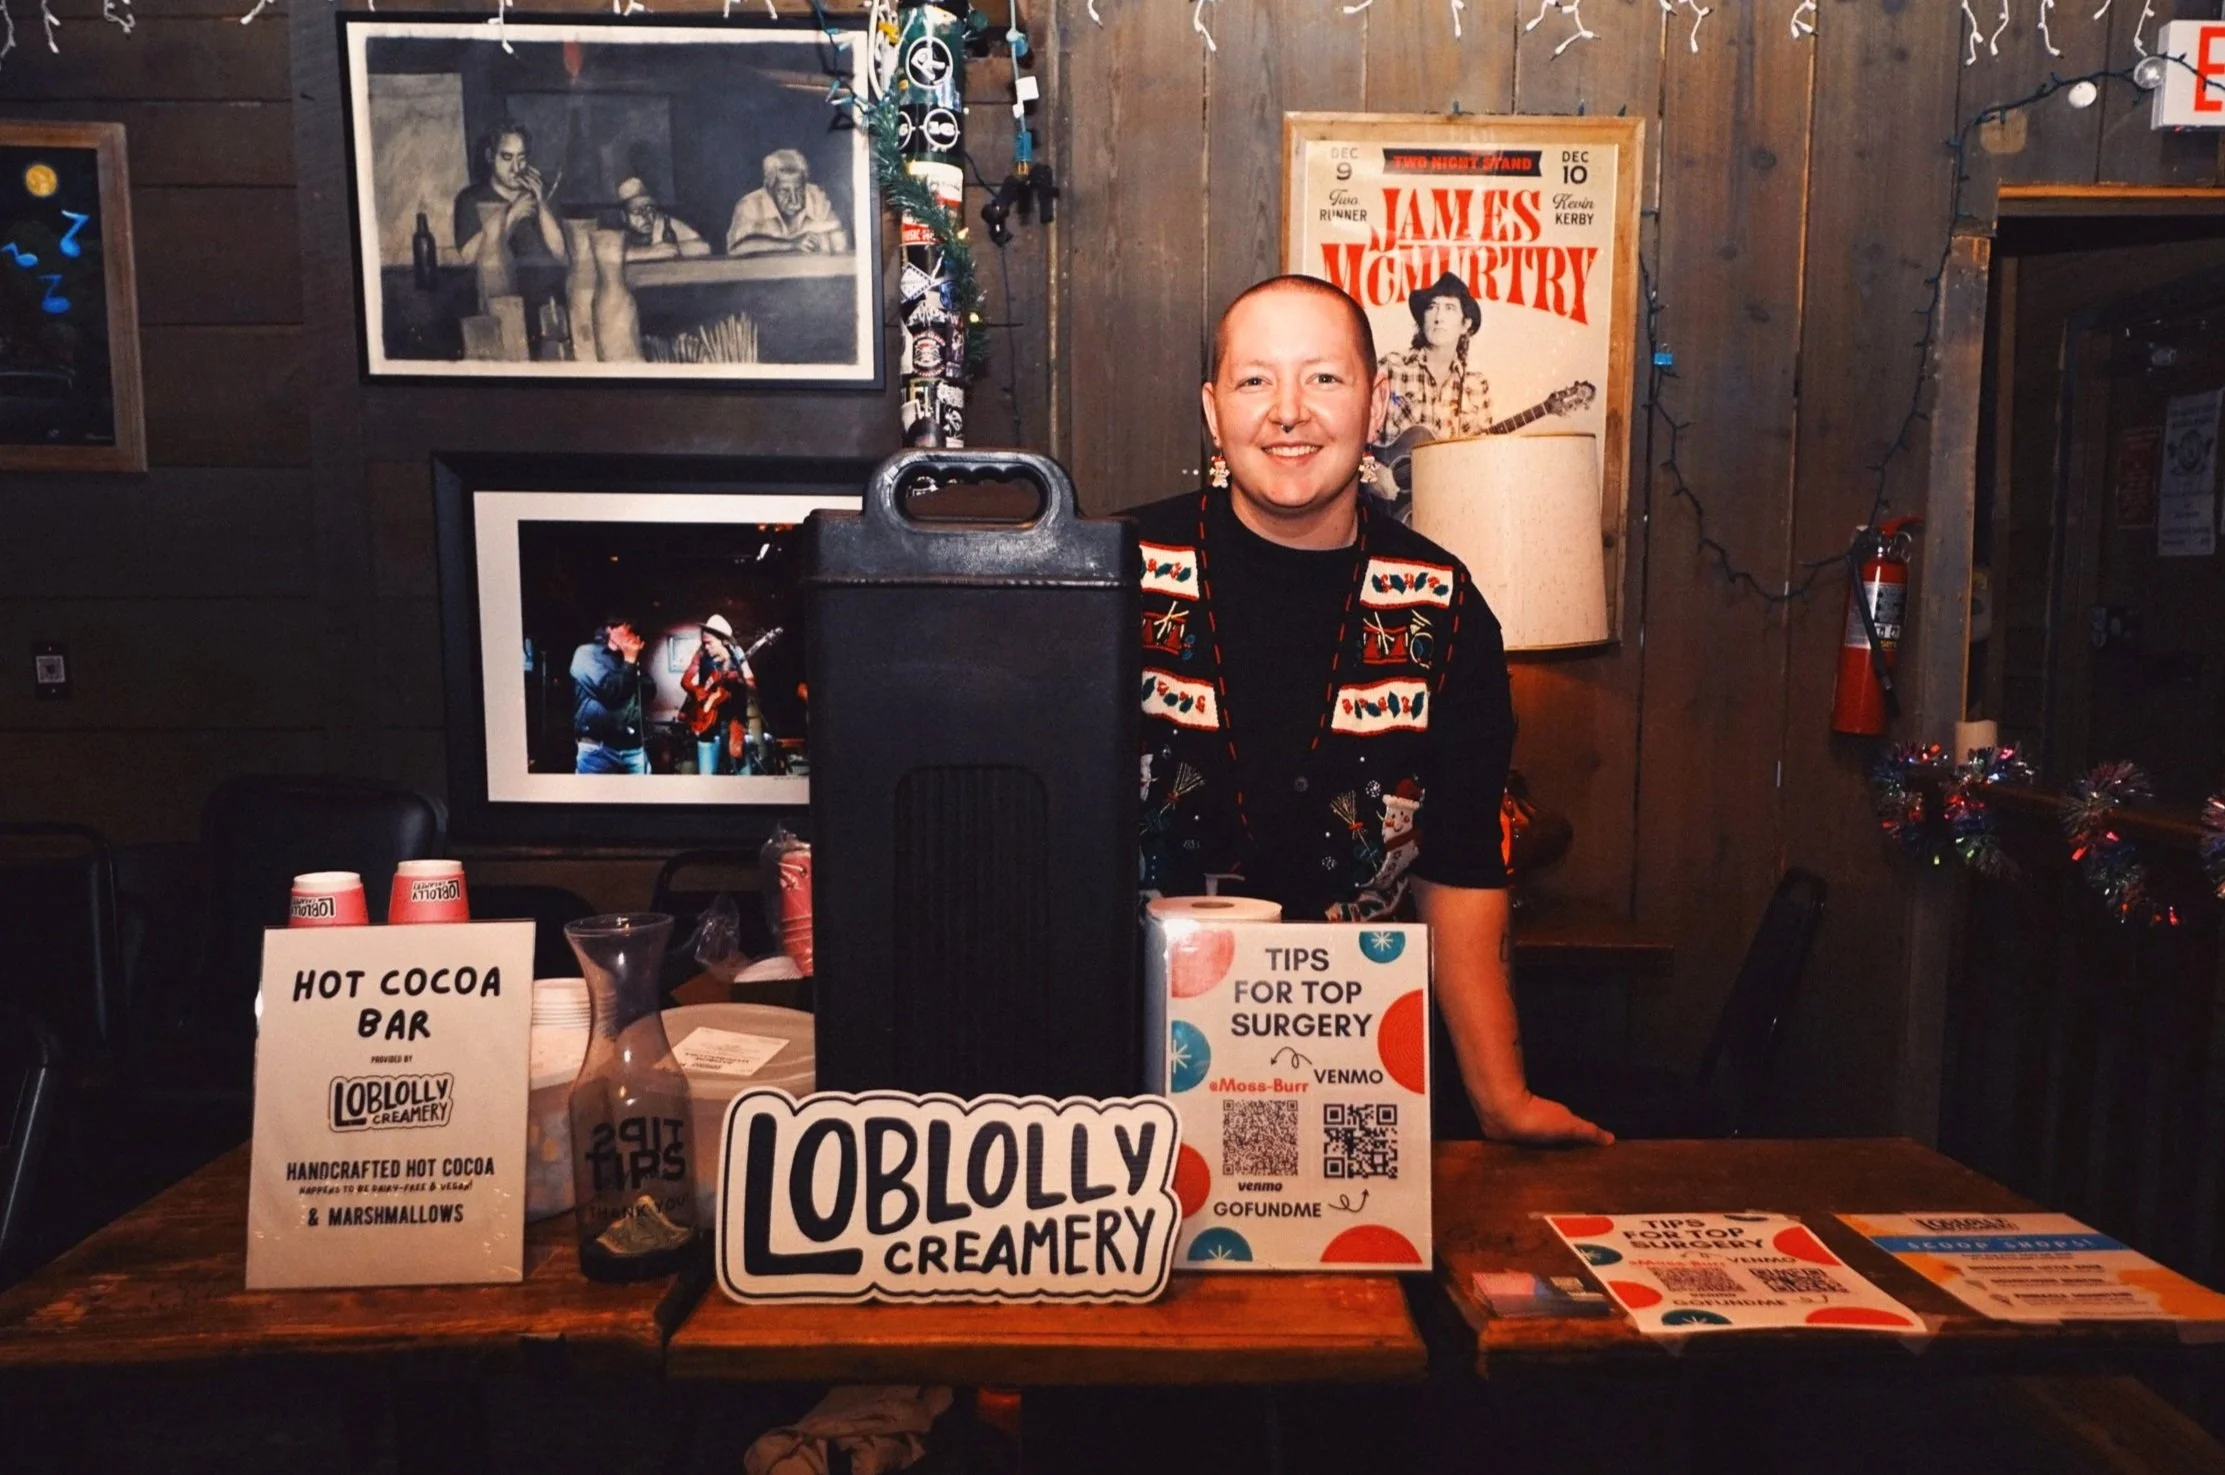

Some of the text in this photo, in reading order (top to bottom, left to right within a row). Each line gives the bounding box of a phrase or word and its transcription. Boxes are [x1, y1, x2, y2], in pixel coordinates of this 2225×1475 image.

[1331, 147, 1359, 159] DEC
[1562, 151, 1589, 163] DEC
[1393, 155, 1532, 170] TWO NIGHT STAND
[1336, 162, 1352, 181] 9
[1563, 165, 1588, 184] 10
[1329, 189, 1359, 206] Two
[1552, 193, 1595, 211] Kevin
[1319, 208, 1367, 222] RUNNER
[1368, 188, 1541, 253] JAMES
[1555, 213, 1594, 225] KERBY
[412, 880, 460, 901] LOBLOLLY
[1265, 947, 1330, 972] TIPS
[292, 966, 501, 1001] HOT COCOA
[1233, 980, 1363, 1004] FOR TOP
[358, 1008, 431, 1041] BAR
[1231, 1013, 1373, 1037] SURGERY
[371, 1055, 413, 1064] PROVIDED BY
[1313, 1068, 1384, 1085] VENMO
[1209, 1078, 1309, 1094] @Moss-Burr
[334, 1078, 449, 1127] LOBLOLLY
[372, 1102, 448, 1125] CREAMERY
[286, 1157, 495, 1180] HANDCRAFTED HOT COCOA
[299, 1184, 341, 1195] HAPPENS
[343, 1184, 354, 1193] TO
[357, 1183, 369, 1193] BE
[744, 1112, 1156, 1275] LOBLOLLY
[1237, 1181, 1283, 1193] venmo
[308, 1203, 464, 1226] & MARSHMALLOWS
[1213, 1201, 1322, 1218] GOFUNDME
[1641, 1218, 1706, 1229] TIPS
[884, 1205, 1157, 1275] CREAMERY
[1623, 1227, 1745, 1240] FOR TOP
[1630, 1238, 1764, 1249] SURGERY
[1726, 1256, 1797, 1264] VENMO
